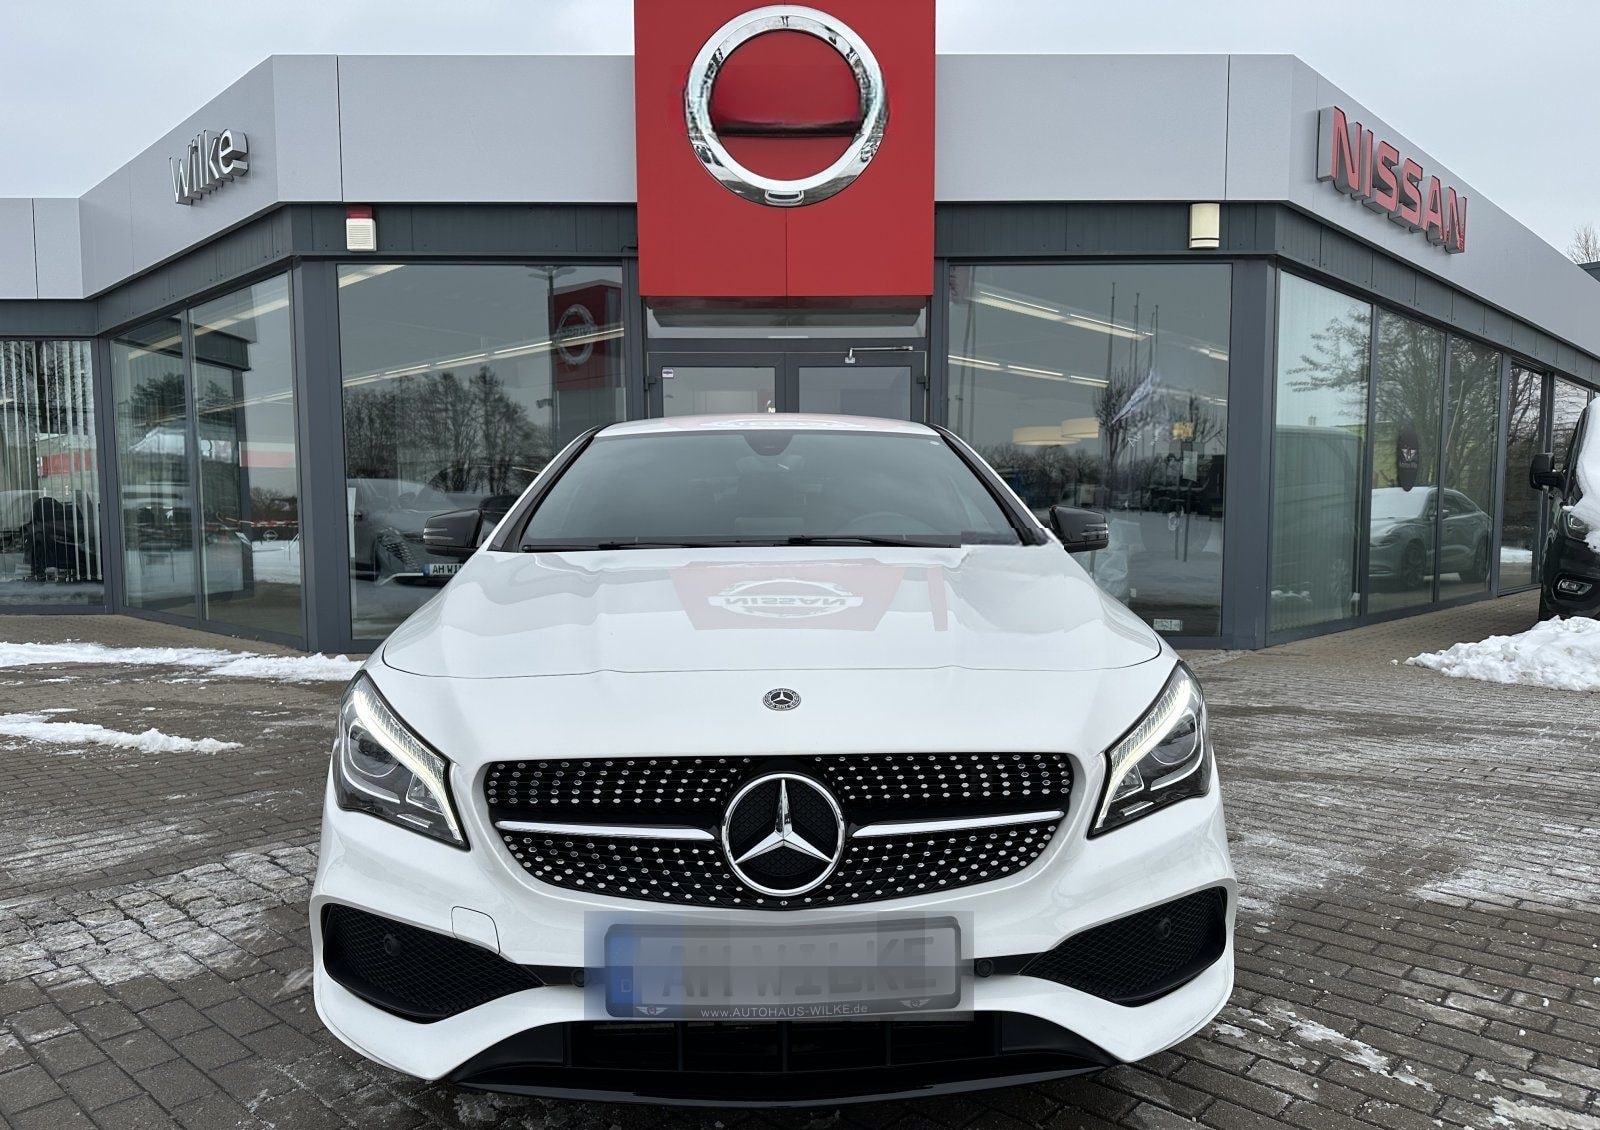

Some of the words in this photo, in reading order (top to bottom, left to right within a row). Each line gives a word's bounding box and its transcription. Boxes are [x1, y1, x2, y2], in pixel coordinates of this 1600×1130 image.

[1318, 105, 1467, 253] NISSAN
[432, 565, 445, 574] AH
[752, 935, 938, 997] WILKE
[700, 1003, 869, 1018] www.AUTOHAUS-WILKE.de
